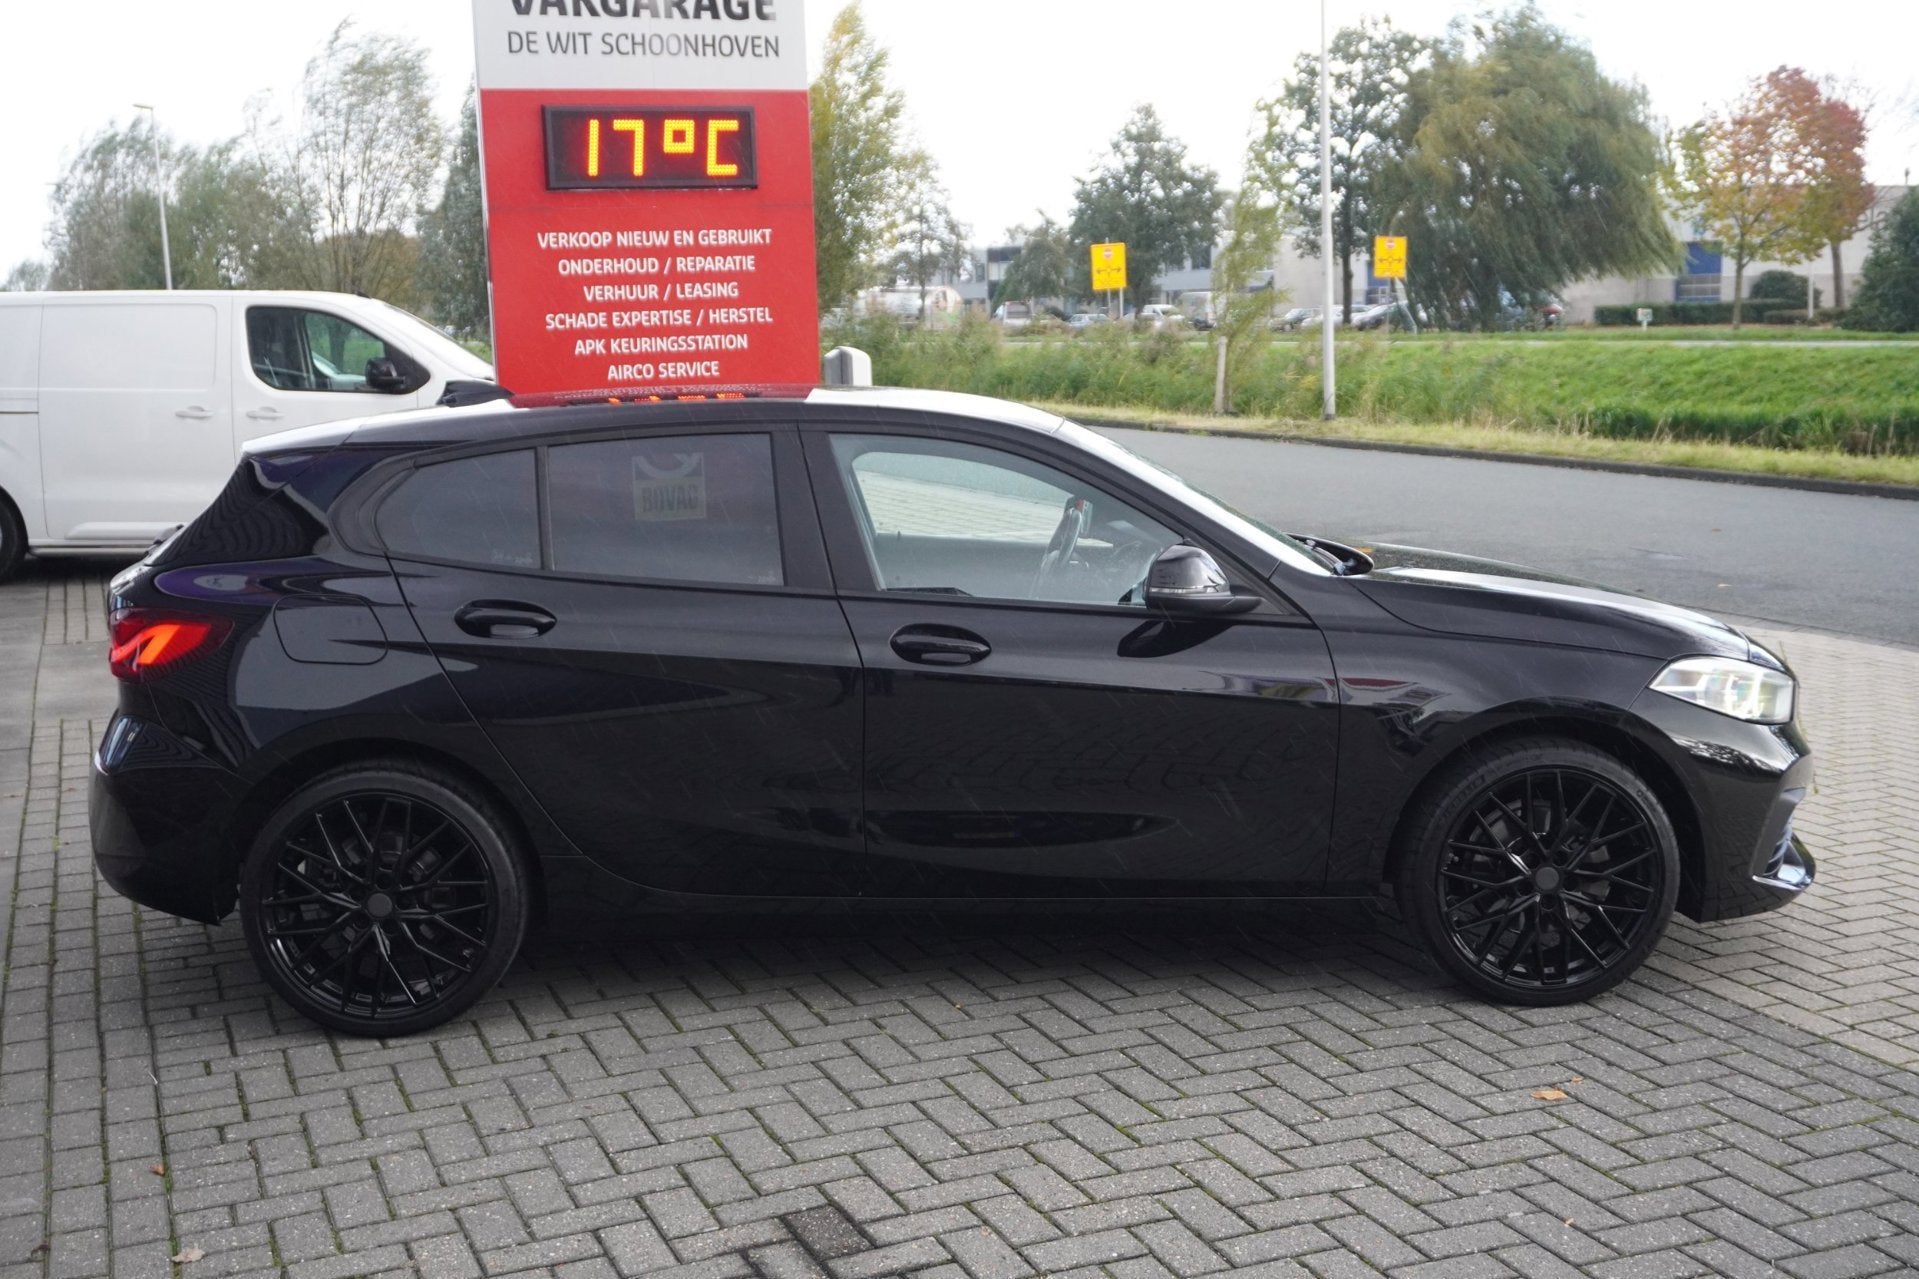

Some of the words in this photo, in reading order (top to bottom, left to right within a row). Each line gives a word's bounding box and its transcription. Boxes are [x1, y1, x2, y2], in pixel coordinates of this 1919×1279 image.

[508, 31, 539, 54] DE
[546, 32, 592, 55] WIT
[601, 33, 780, 58] SCHOONHOVEN
[537, 231, 612, 250] VERKOOP
[617, 231, 669, 247] NIEUW
[674, 230, 694, 246] EN
[698, 228, 772, 245] GEBRUIKT
[558, 257, 659, 276] ONDERHOUD
[677, 255, 756, 272] REPARATIE
[584, 284, 659, 302] VERHUUR
[677, 281, 739, 299] LEASING
[545, 312, 607, 330] SCHADE
[612, 309, 692, 327] EXPERTISE
[709, 307, 773, 324] HERSTEL
[574, 338, 606, 356] APK
[611, 334, 748, 354] KEURINGSSTATION
[607, 363, 653, 381] AIRCO
[658, 360, 720, 378] SERVICE
